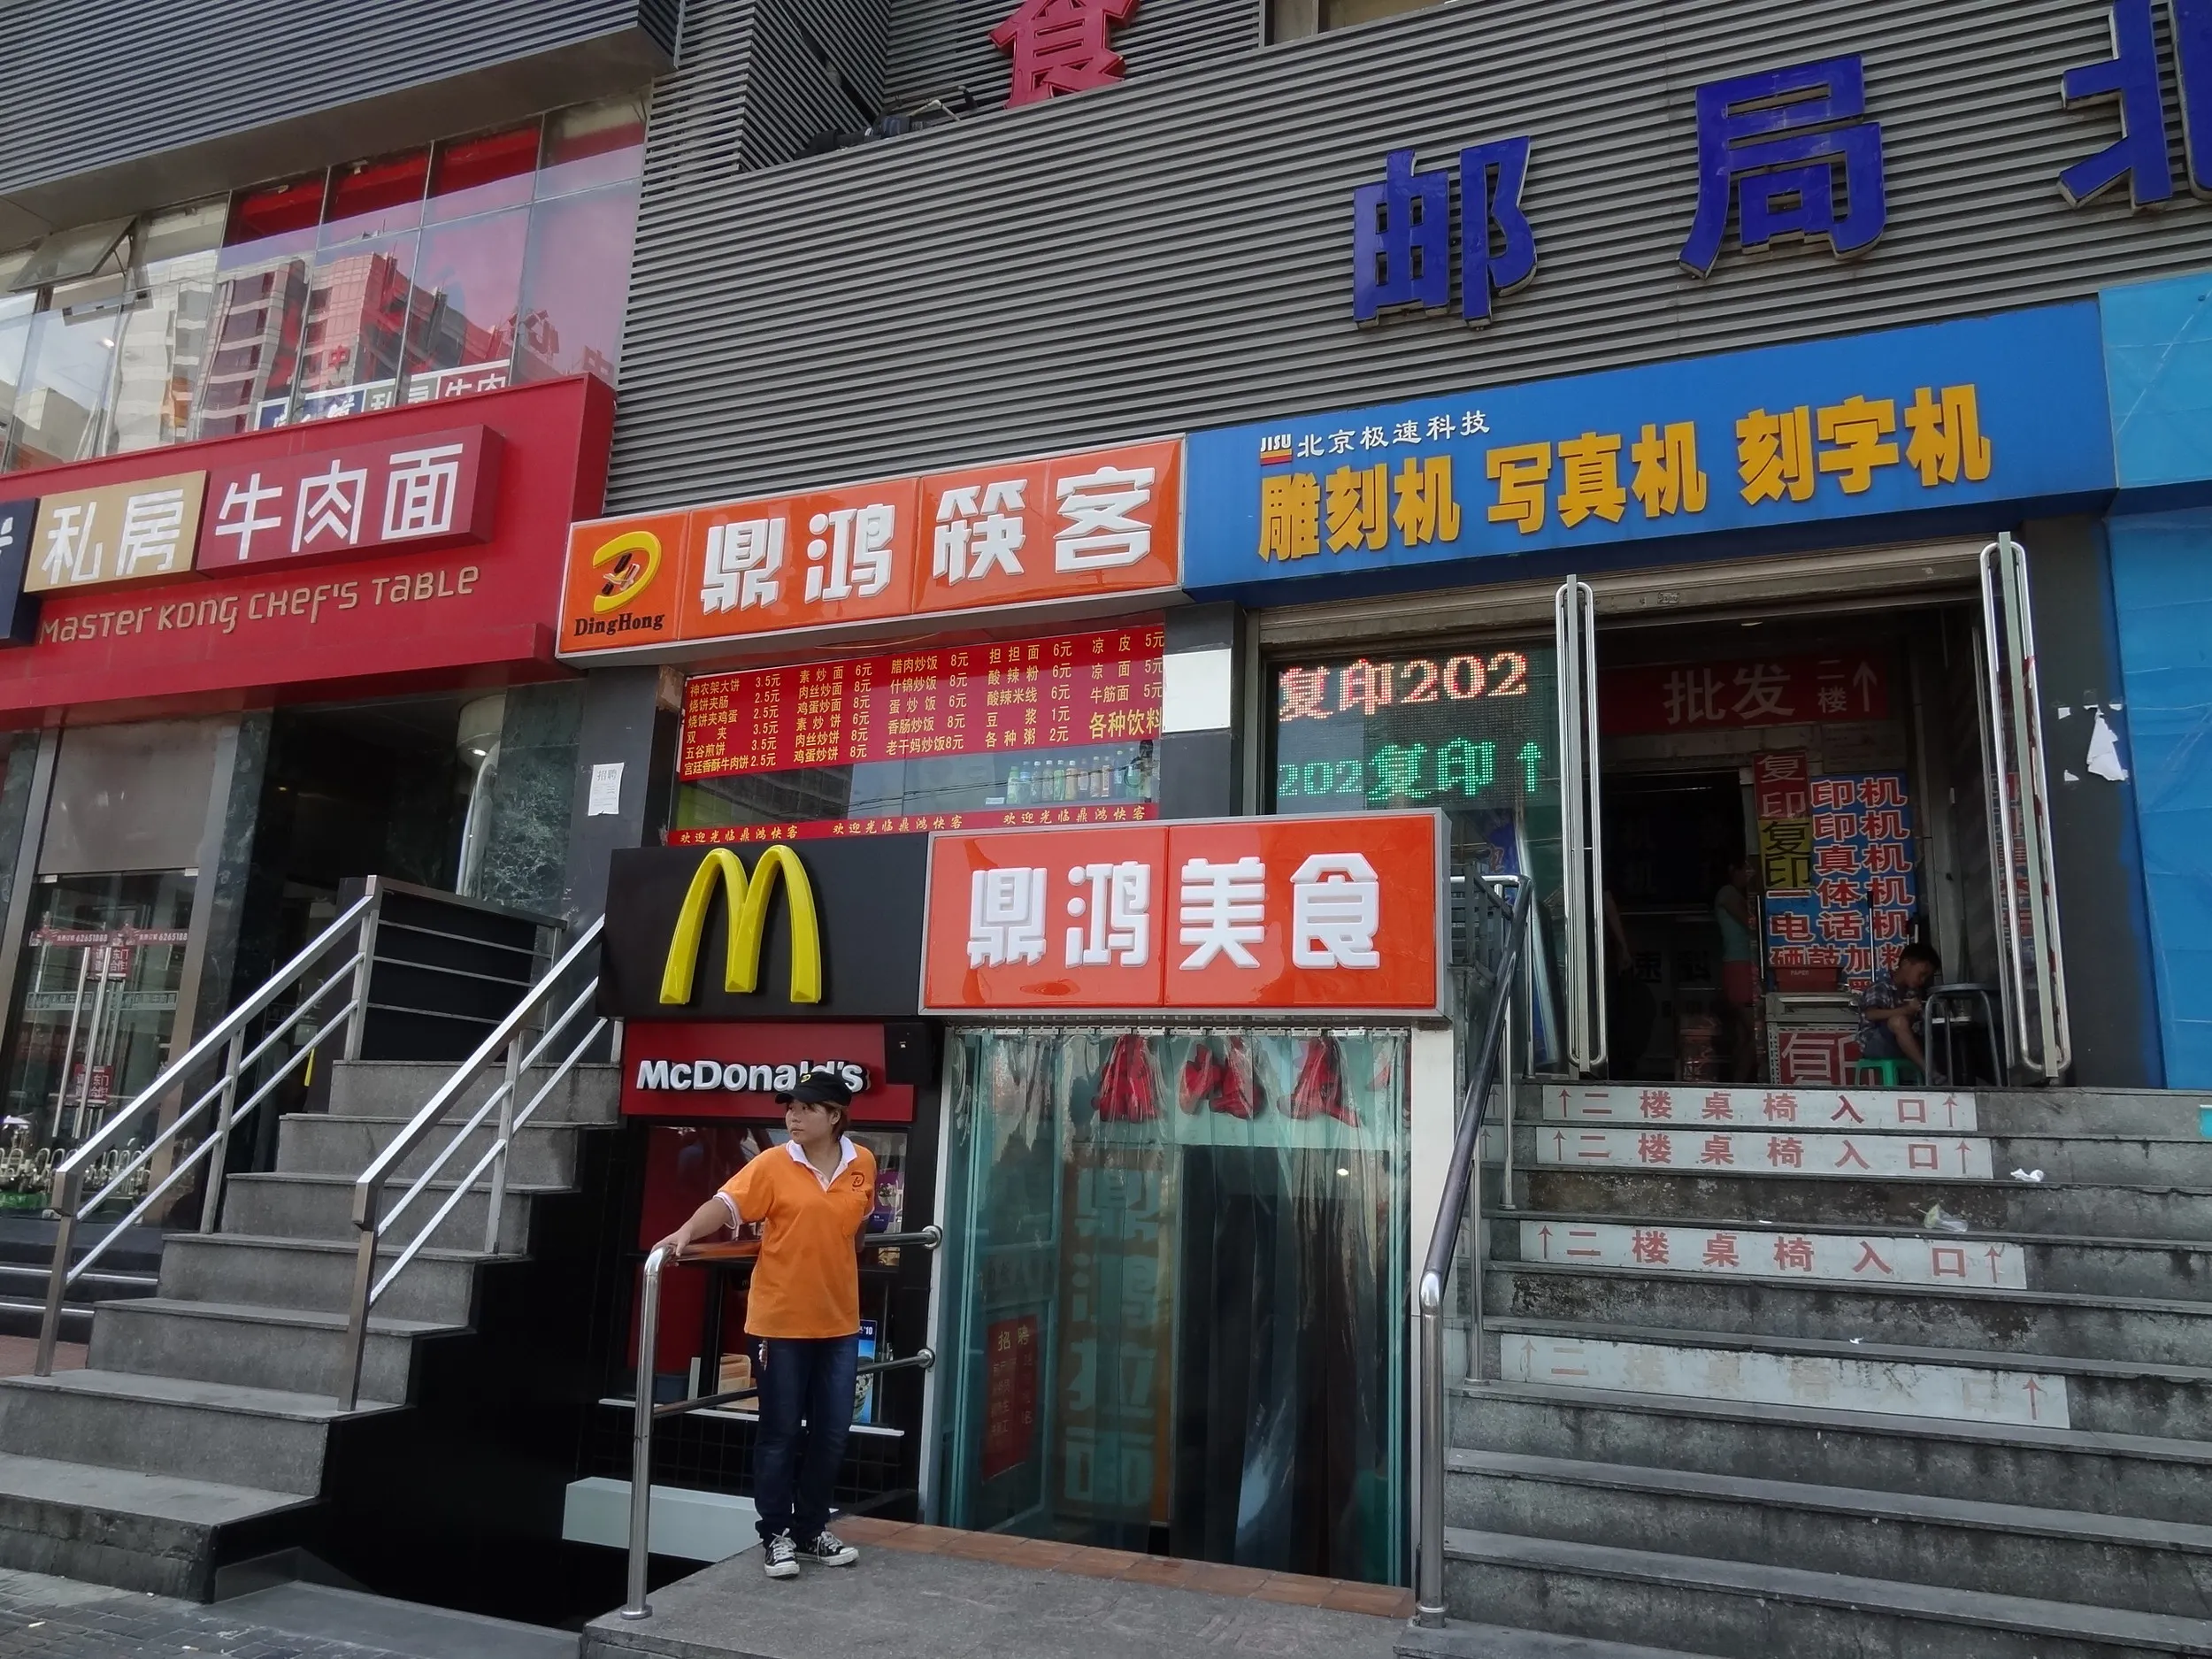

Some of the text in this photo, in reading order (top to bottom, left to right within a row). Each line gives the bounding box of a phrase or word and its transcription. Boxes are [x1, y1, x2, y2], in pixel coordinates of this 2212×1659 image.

[1260, 434, 1292, 453] JISU
[1296, 410, 1491, 457] 北京极速科技
[1258, 382, 1993, 563] 雕刻机 写真机 刻字机
[700, 465, 1156, 615] 鼎鸿筷客
[573, 612, 665, 637] DingHong
[1145, 632, 1165, 649] 5元
[891, 652, 969, 674] 腊肉炒饭 8元
[989, 641, 1072, 664] 担担面 6元
[799, 663, 872, 684] 素炒面 6元
[988, 663, 1072, 686] 酸辣粉 6元
[1145, 657, 1164, 674] 5元
[690, 673, 781, 697] 神农架大饼 3.5元
[798, 680, 872, 700] 肉丝炒面 8元
[890, 672, 968, 695] 什锦炒饭 8元
[1090, 682, 1164, 704] 牛筋面 5元
[1663, 663, 1796, 726] 批发
[688, 689, 780, 712] 烧饼夹肠 2.5元
[797, 695, 871, 716] 鸡蛋炒面 8元
[889, 693, 967, 715] 蛋炒饭 6元
[987, 685, 1071, 707] 酸辣米线 6元
[687, 705, 780, 729] 烧饼夹鸡蛋 2.5元
[795, 711, 870, 733] 素炒饼 6元
[887, 714, 965, 735] 香肠炒饭 8元
[1051, 706, 1071, 722] 1元
[1089, 707, 1163, 739] 各种饮料
[753, 721, 779, 735] 3.5元
[795, 728, 869, 748] 肉丝炒饼 8元
[985, 726, 1069, 749] 各种粥 2元
[751, 737, 777, 751] 3.5元
[794, 744, 867, 764] 鸡蛋炒饼 8元
[886, 734, 964, 756] 老干妈炒饭 8元
[750, 753, 777, 767] 2.5元
[1756, 754, 1807, 818] 复印
[1810, 777, 1908, 810] 印机
[833, 814, 963, 834] 欢迎光临鼎鸿快客
[1002, 805, 1146, 826] 欢迎光临鼎鸿快客
[1811, 810, 1911, 843] 印机
[680, 825, 798, 843] 欢迎光临鼎鸿快客
[1762, 821, 1811, 888] 复印
[1815, 844, 1913, 874] 真机
[967, 851, 1381, 970] 鼎鸿美食
[1769, 910, 1911, 943] 电话机
[1581, 1090, 1928, 1125] 二楼桌椅入口
[1578, 1133, 1939, 1171] 二楼桌椅入口
[1565, 1230, 1966, 1278] 二楼桌椅入口
[997, 1324, 1031, 1352] 招聘
